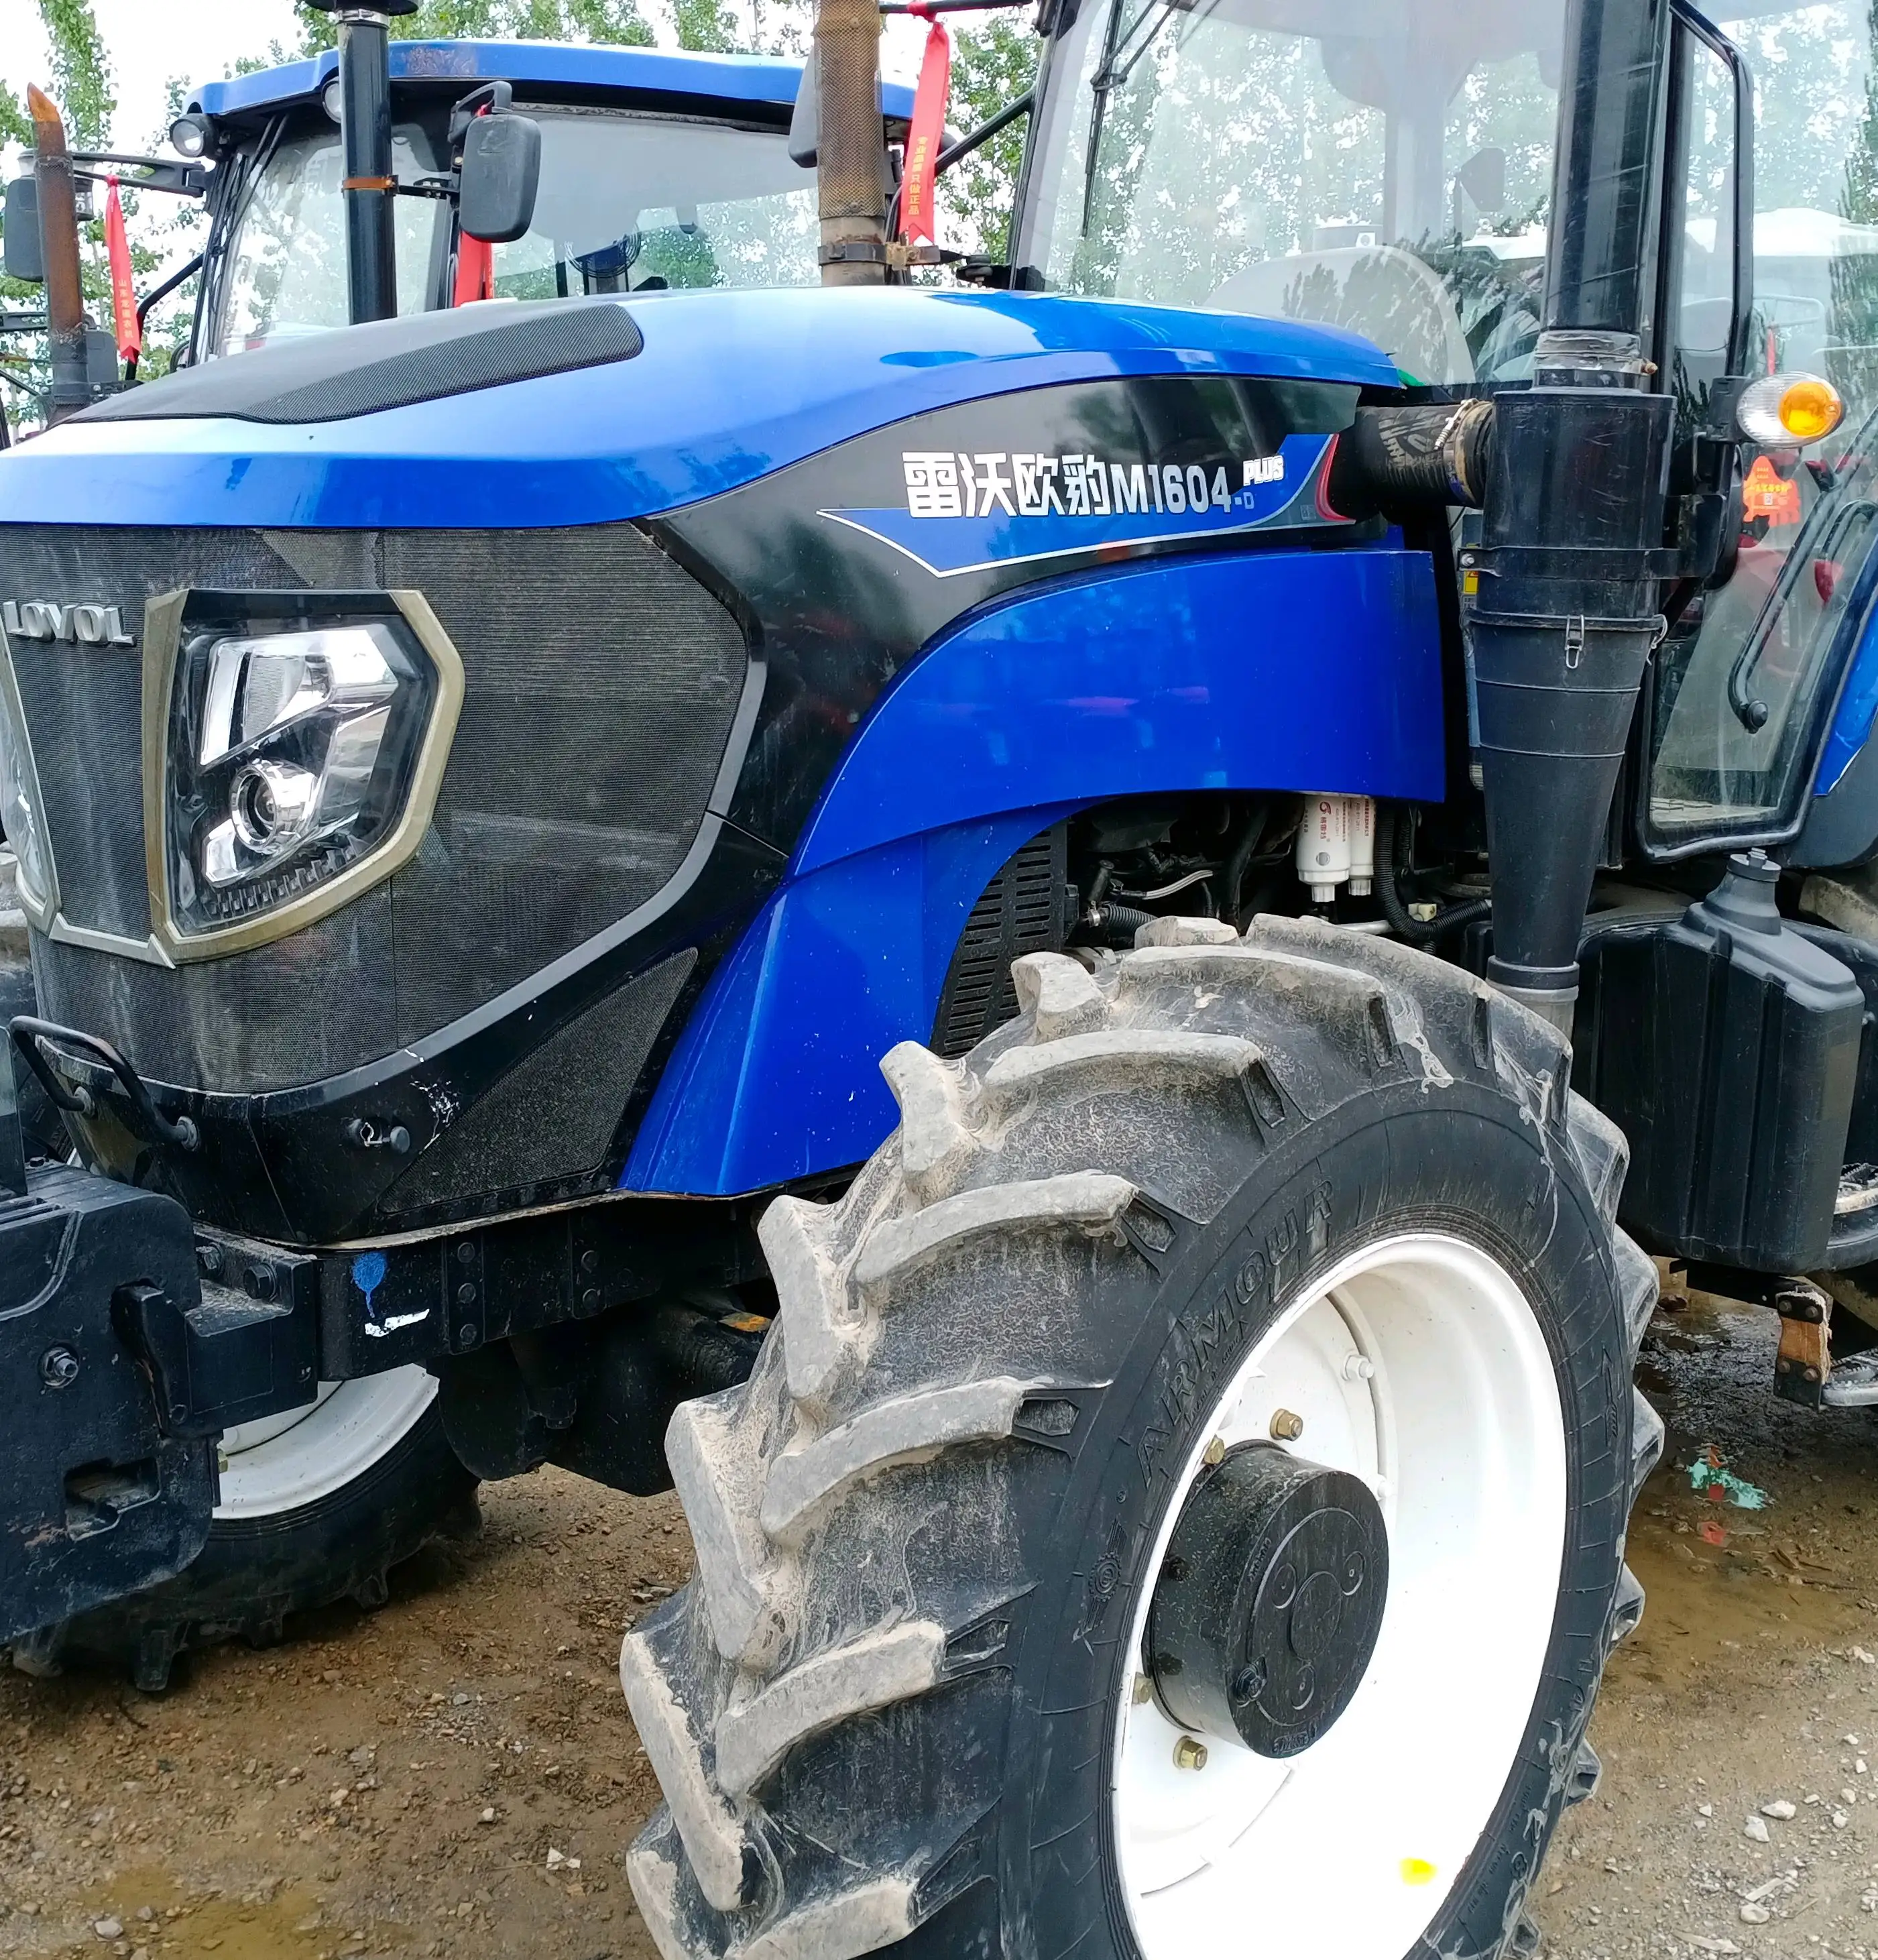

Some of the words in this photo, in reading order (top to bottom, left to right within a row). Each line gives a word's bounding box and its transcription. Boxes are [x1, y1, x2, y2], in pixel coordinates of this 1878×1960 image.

[1243, 455, 1284, 487] PLUS
[3, 601, 136, 646] LOVOL
[1136, 1180, 1334, 1490] ARMOUR
